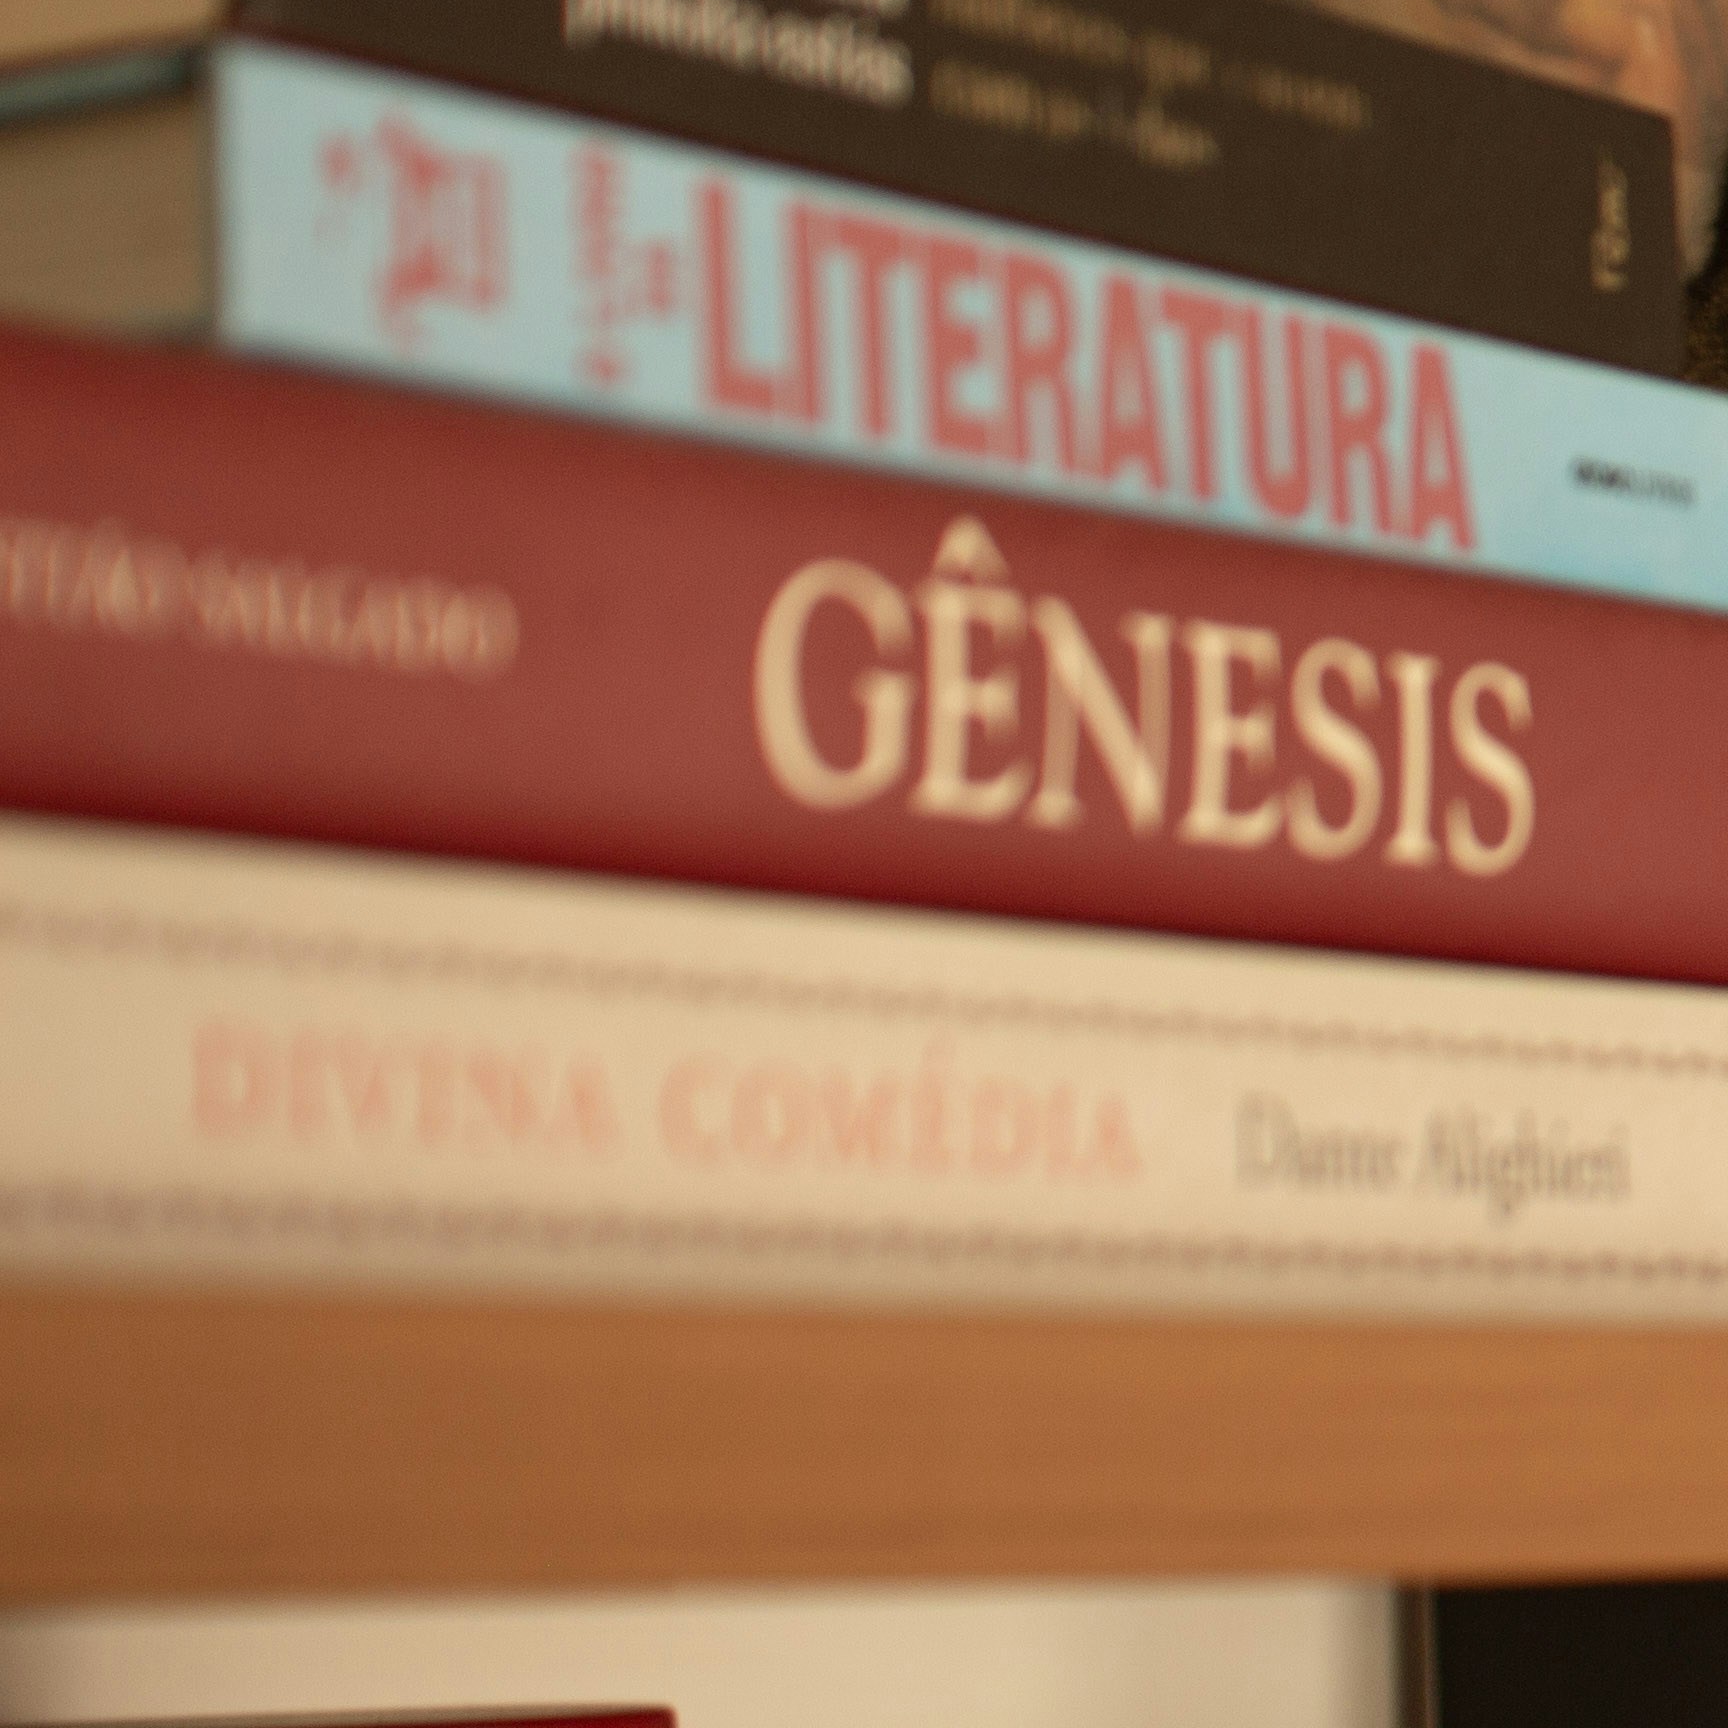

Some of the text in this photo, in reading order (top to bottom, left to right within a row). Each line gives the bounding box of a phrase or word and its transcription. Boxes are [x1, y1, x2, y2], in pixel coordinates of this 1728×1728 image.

[690, 174, 1476, 556] LITERATURA
[752, 514, 1538, 878] GÊNESIS
[189, 1010, 622, 1158] DIVINA
[656, 1028, 1147, 1186] COMÉDIA
